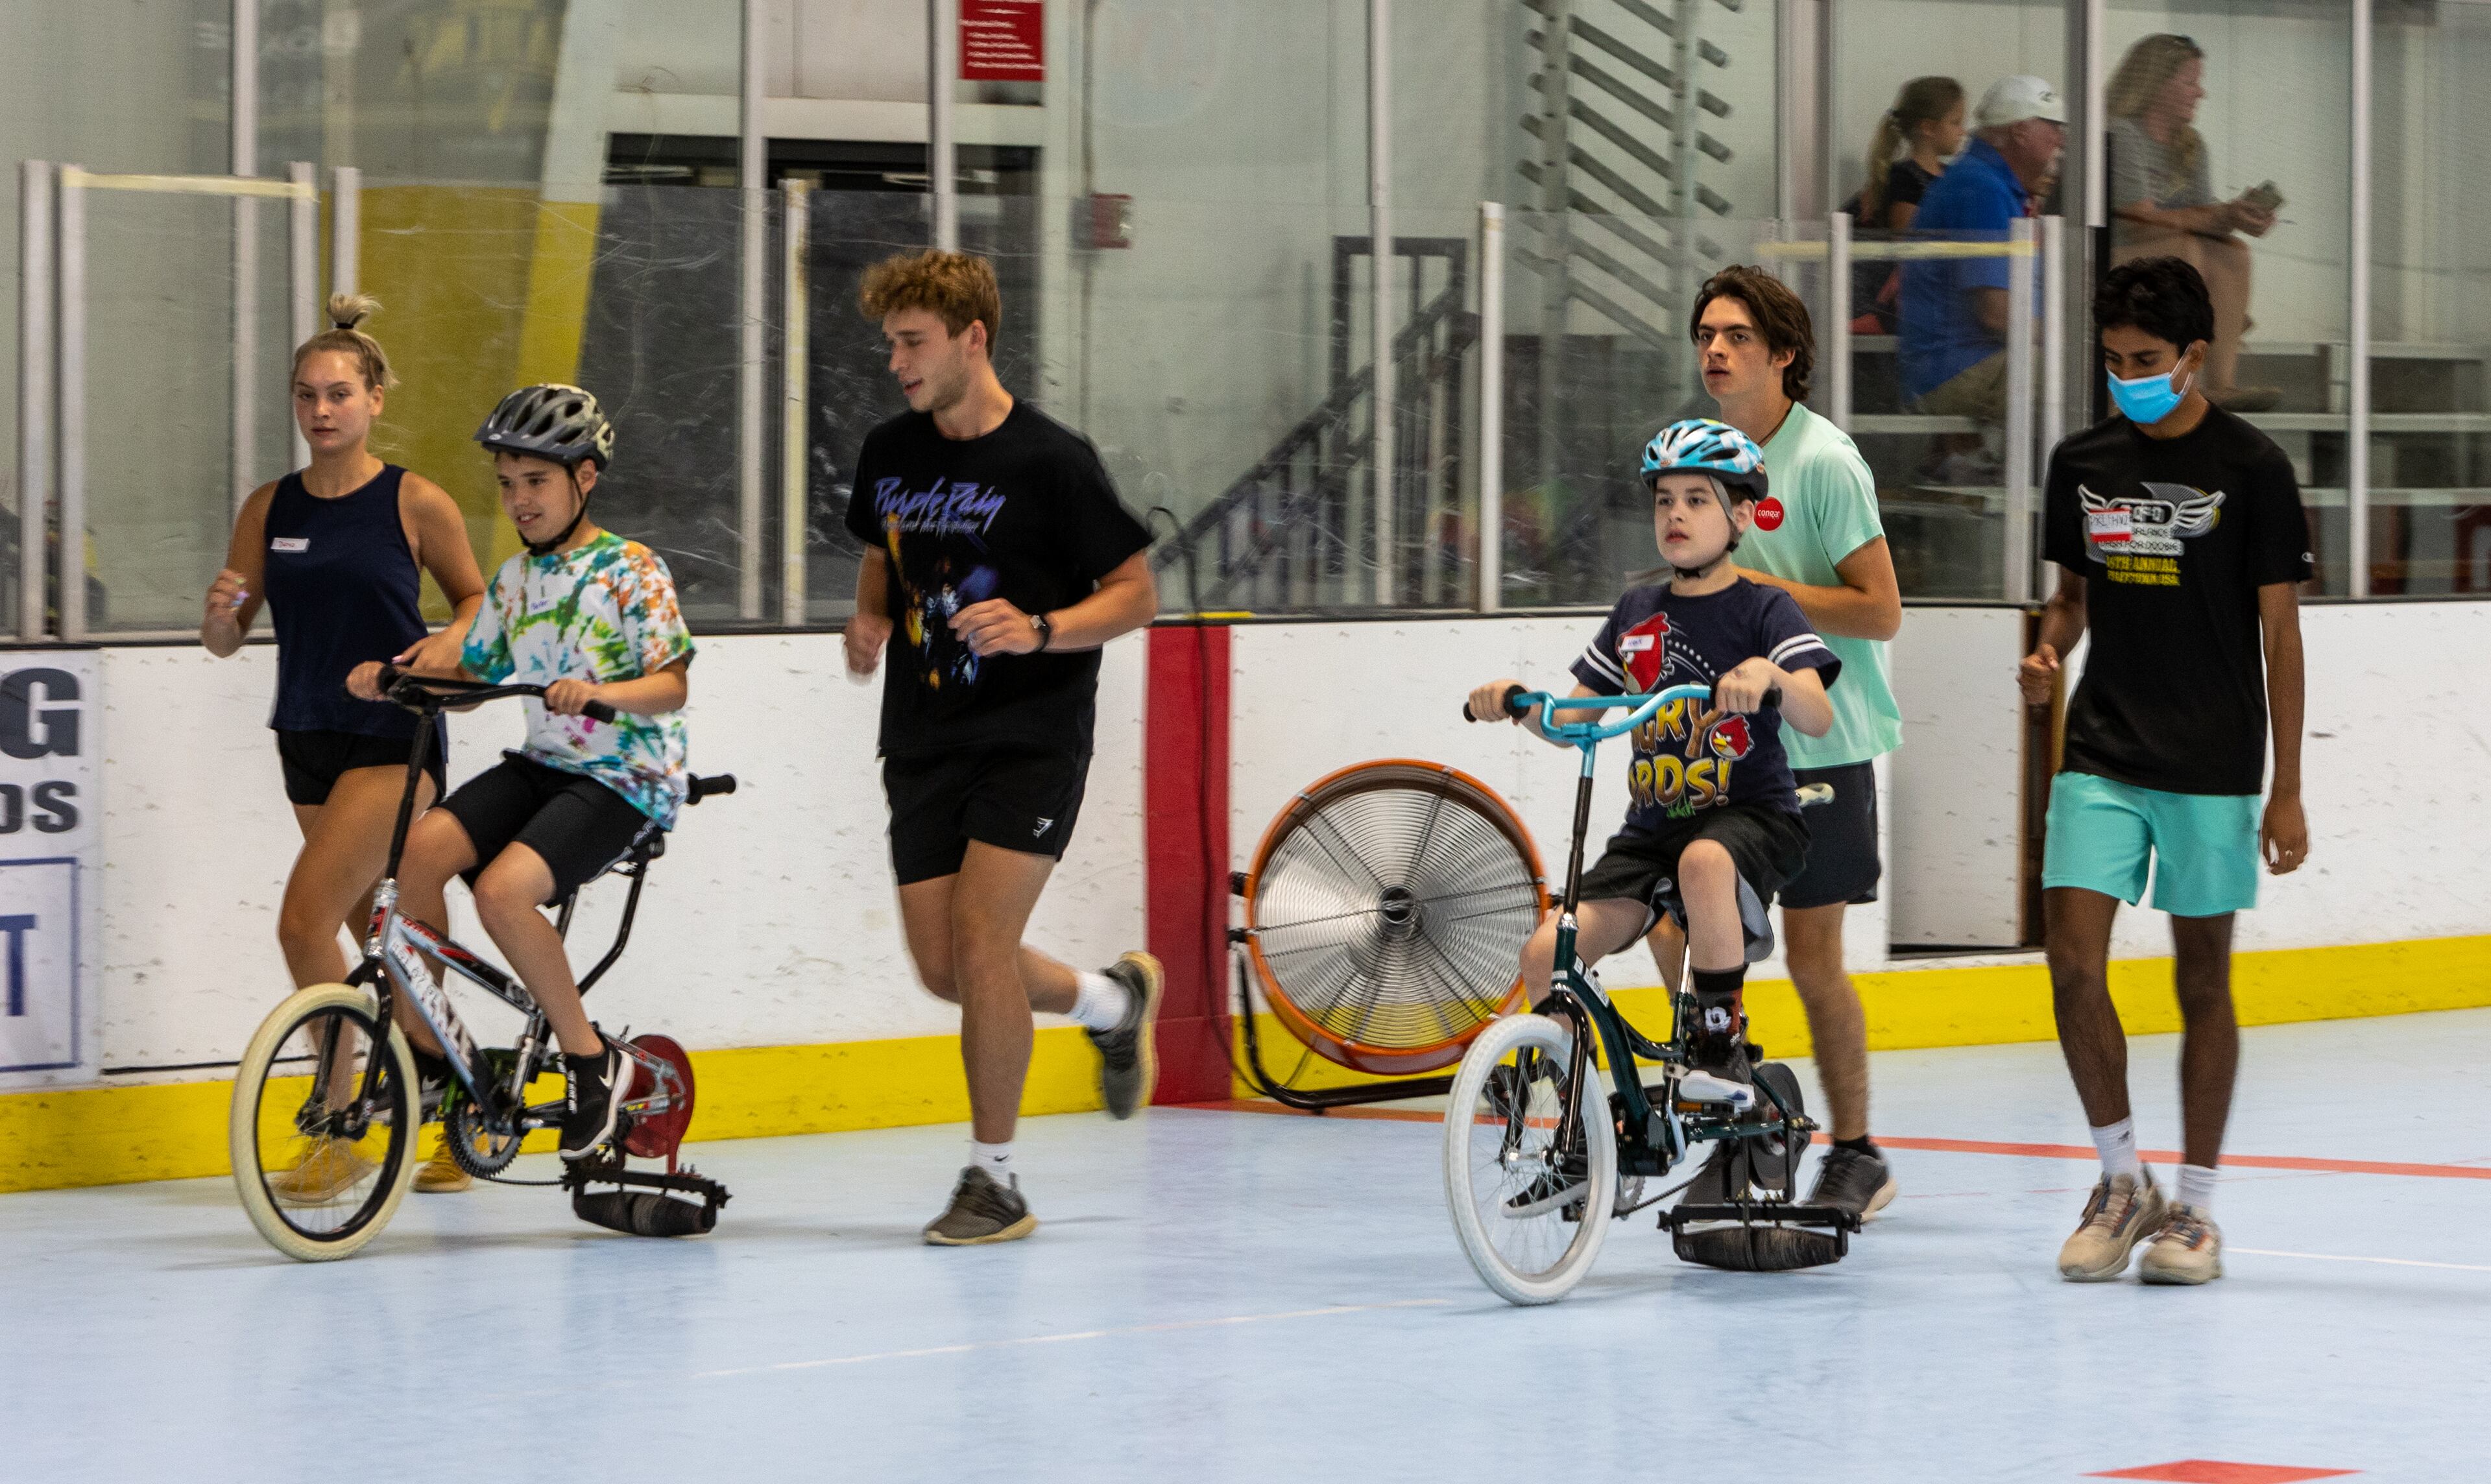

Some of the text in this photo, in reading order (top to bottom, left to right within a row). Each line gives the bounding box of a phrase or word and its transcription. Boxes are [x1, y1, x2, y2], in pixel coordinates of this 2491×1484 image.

[874, 476, 1007, 541] Purple Rain
[0, 668, 80, 760] G
